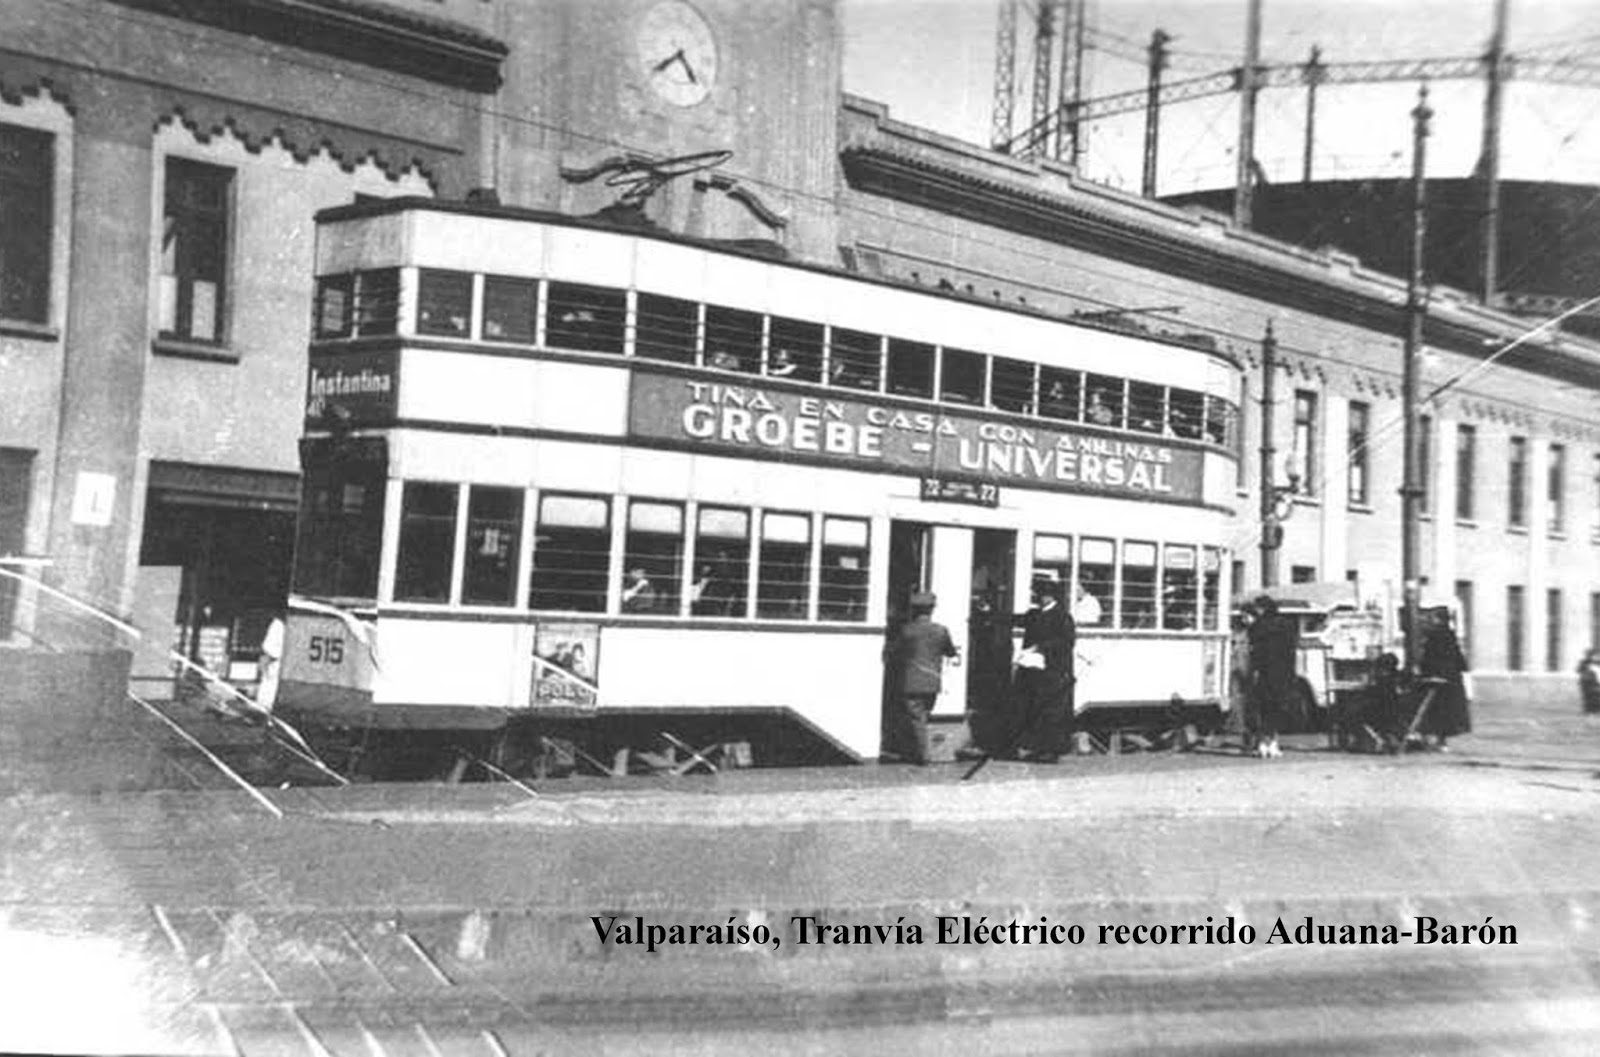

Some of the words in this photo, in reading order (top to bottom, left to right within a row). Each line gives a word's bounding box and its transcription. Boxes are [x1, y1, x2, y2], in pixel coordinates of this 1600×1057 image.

[799, 398, 846, 420] EN
[866, 406, 958, 435] CASA
[979, 422, 1036, 444] CON
[683, 404, 882, 457] GROEBE
[959, 439, 1172, 492] UNIVERSAL
[310, 636, 345, 664] 515
